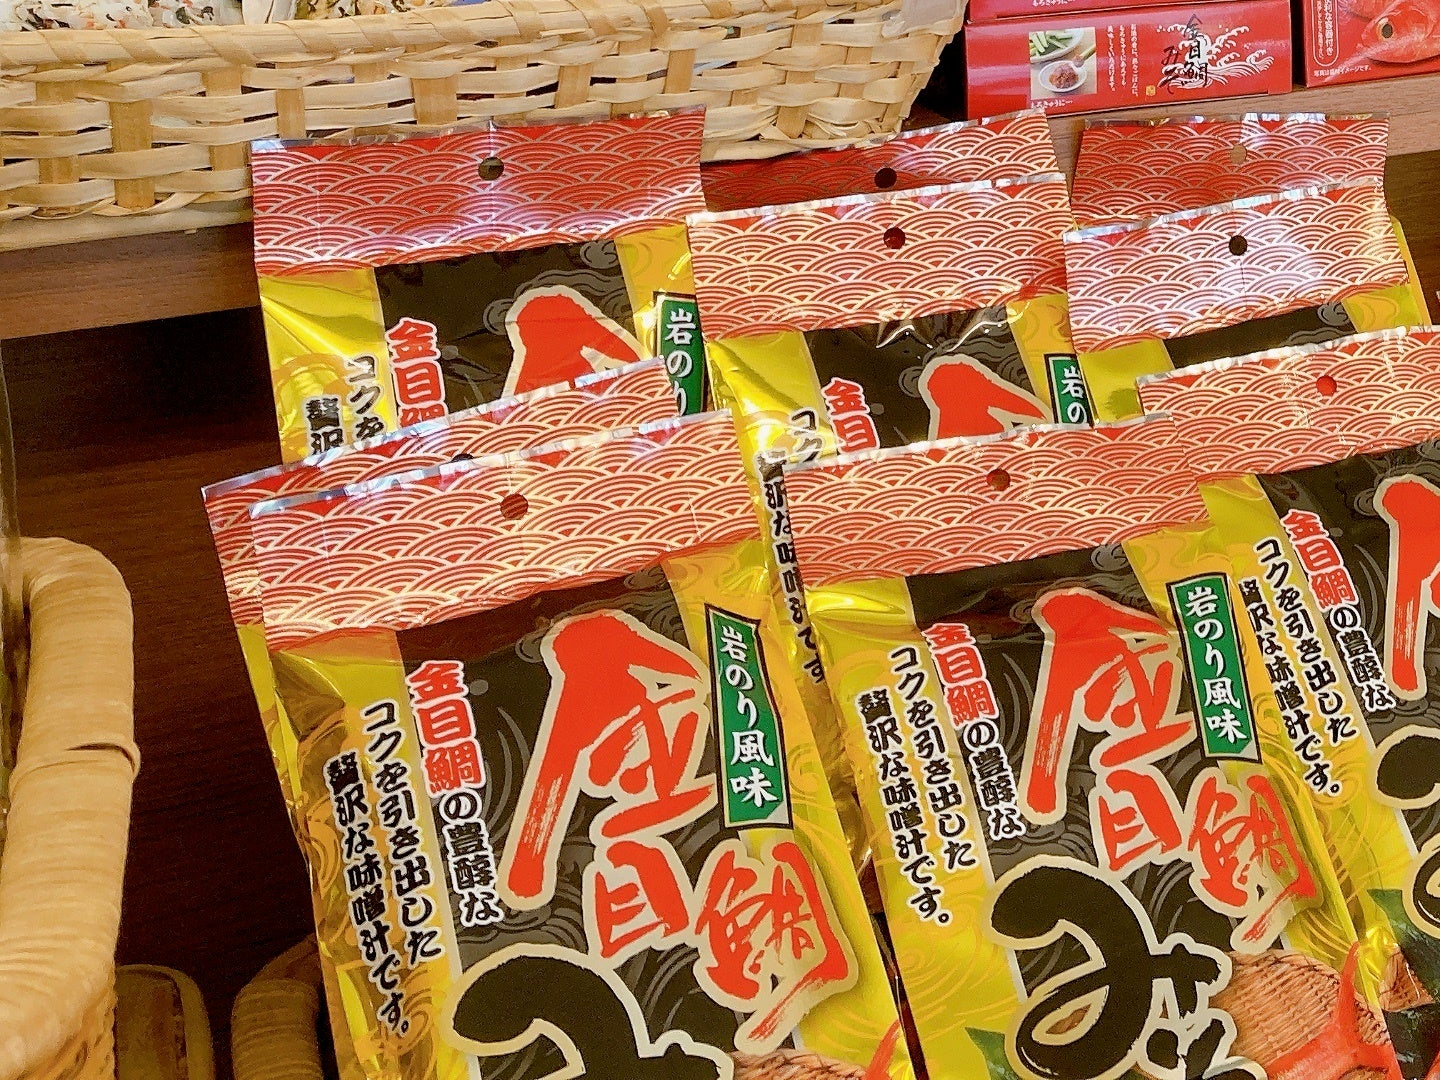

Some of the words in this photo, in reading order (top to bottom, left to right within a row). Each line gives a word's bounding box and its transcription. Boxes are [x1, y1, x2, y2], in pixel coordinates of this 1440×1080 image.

[821, 377, 881, 455] 金目
[718, 622, 780, 810] 岩のり風味
[1183, 585, 1248, 747] 岩のり風味
[1253, 537, 1358, 746] コクを引き出した
[1280, 508, 1397, 712] 金目鯛の豊醇な
[361, 698, 443, 966] コクを引き出した
[406, 658, 504, 927] 金目鯛の豊醇な
[500, 610, 858, 1052] 金目鯛
[856, 687, 954, 928] 贅沢な味噌汁です。
[888, 643, 977, 874] コクを引き出した
[919, 621, 1027, 840] 金目鯛の豊醇な
[1019, 586, 1326, 955] 金目鯛
[324, 752, 414, 1036] 贅沢な味噌汁です。
